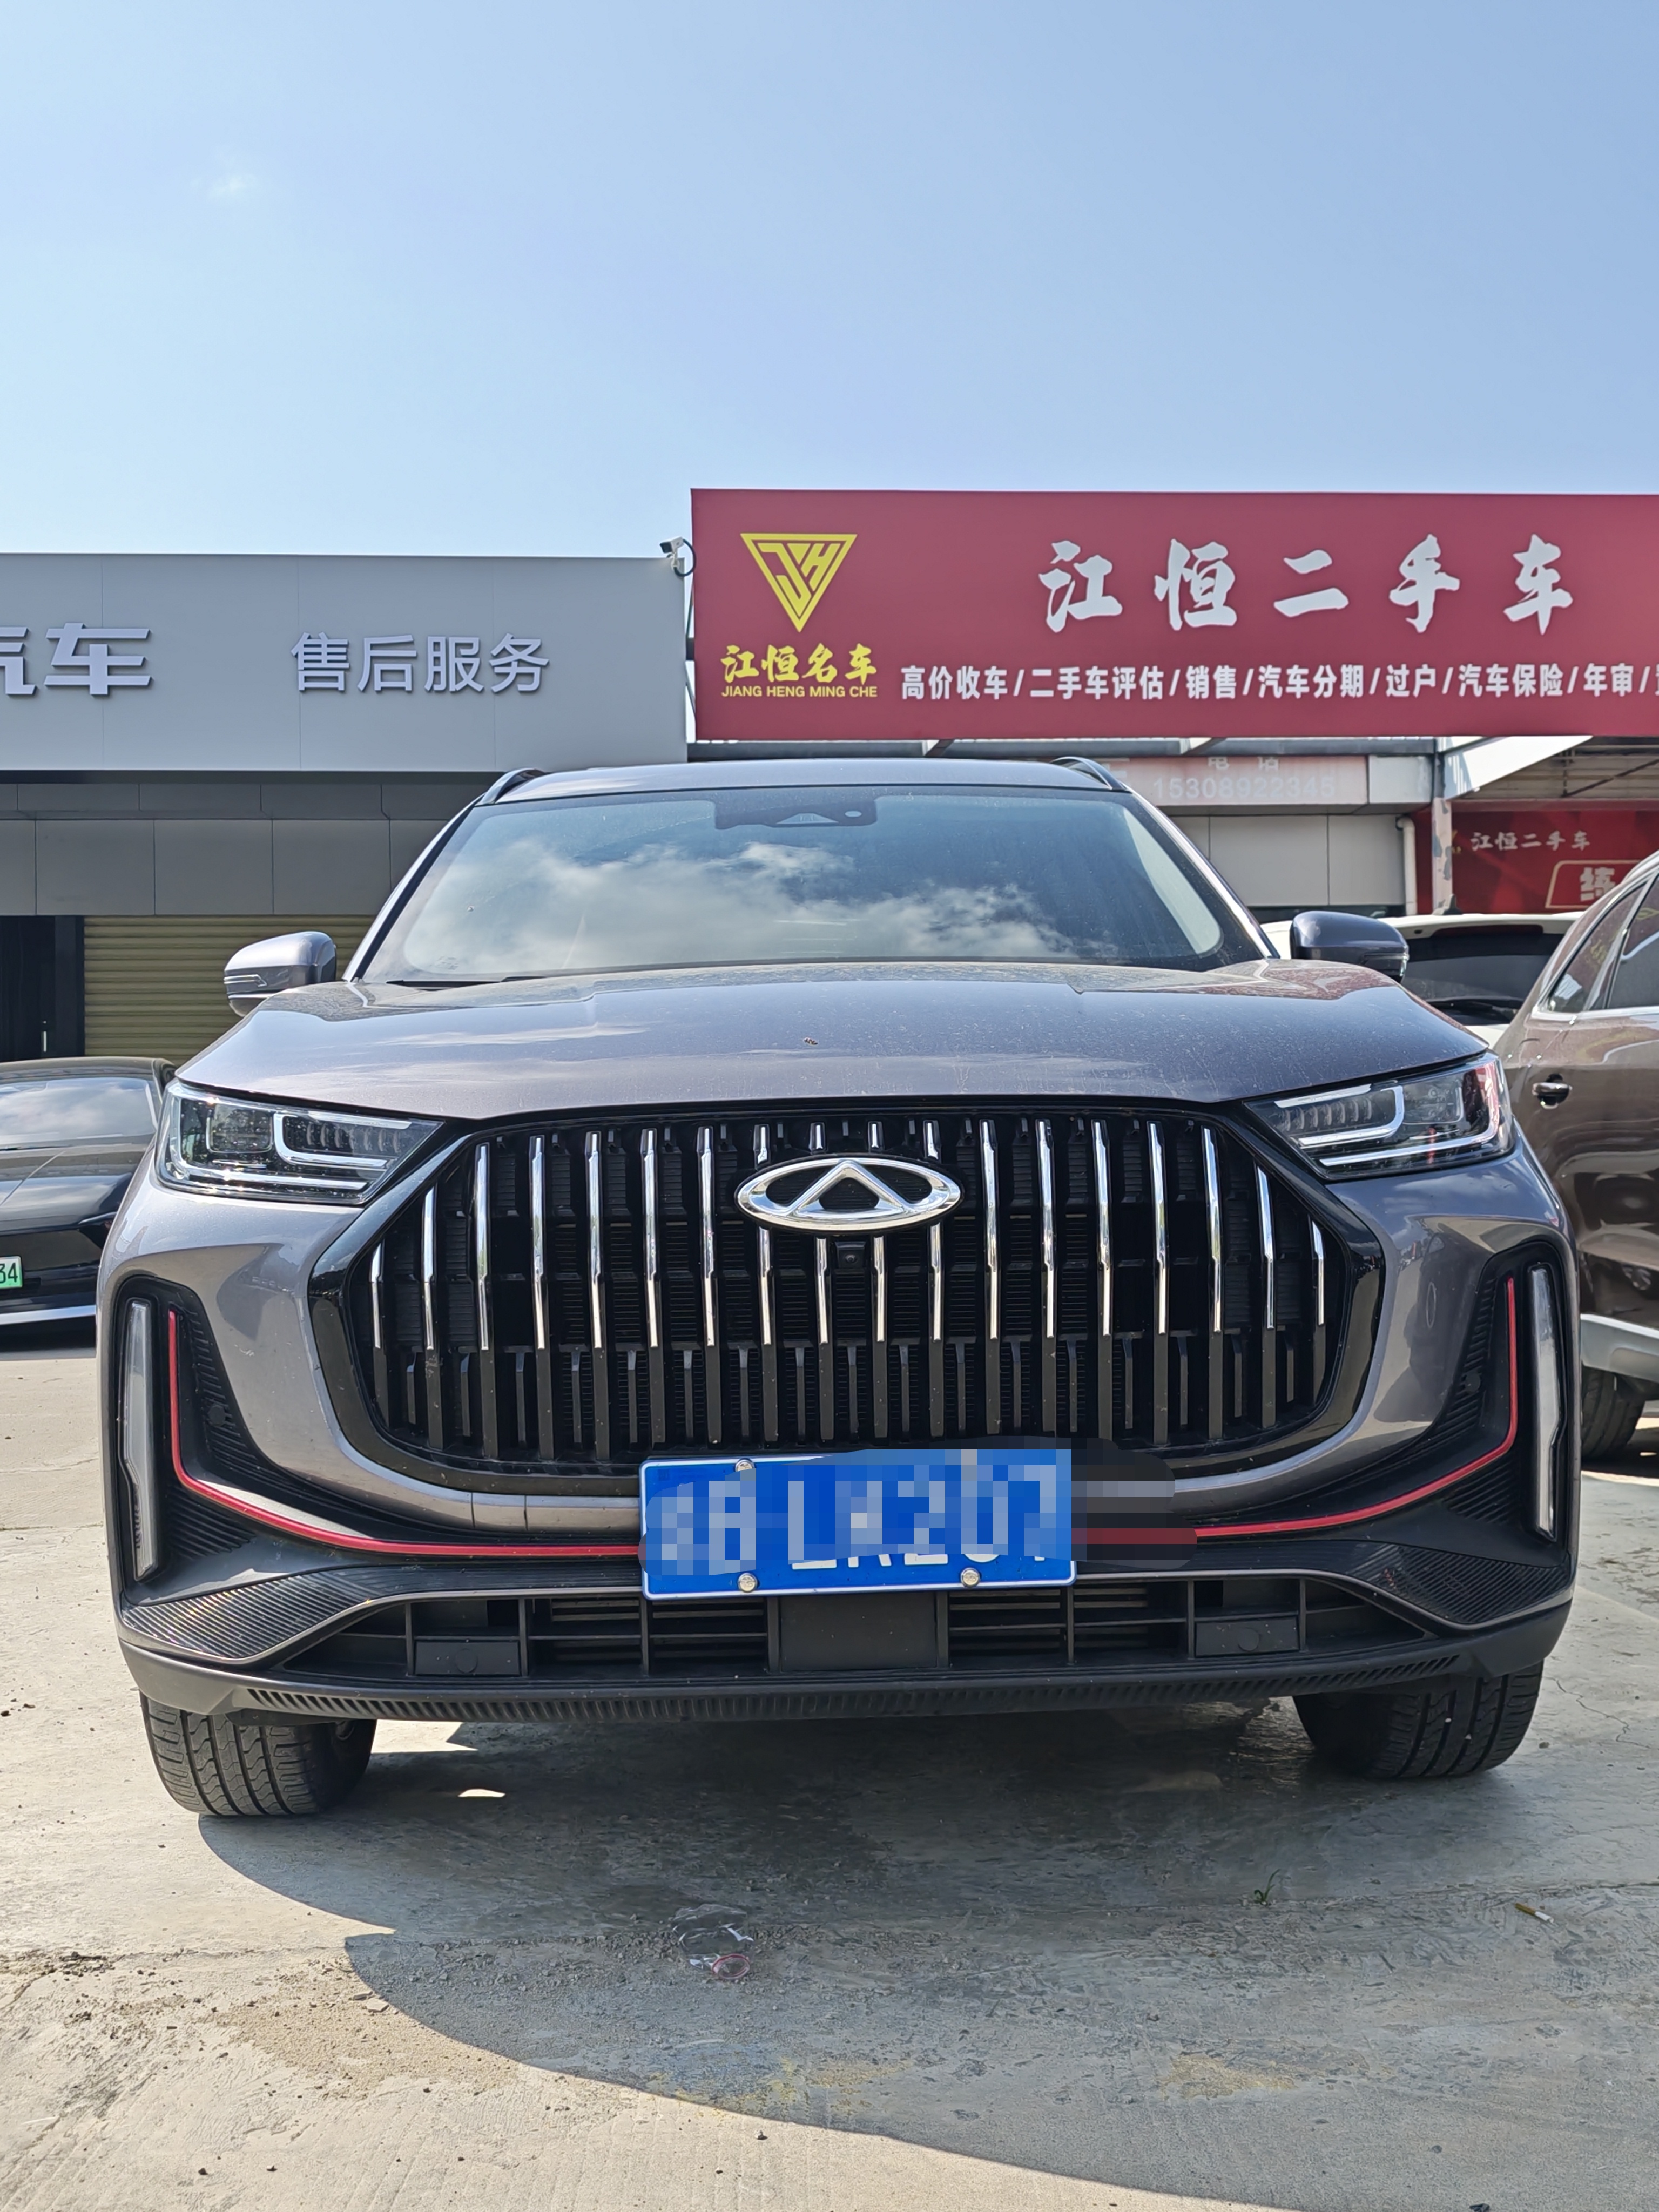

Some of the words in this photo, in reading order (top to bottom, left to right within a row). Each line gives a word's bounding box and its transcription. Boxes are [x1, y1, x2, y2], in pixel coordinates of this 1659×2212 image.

[1038, 534, 1573, 635] 江恒二手车
[291, 632, 550, 693] 售后服务
[720, 642, 876, 685] 江恒名车
[901, 662, 1659, 700] 高价收车/二手车评估/销售/汽车分期/过户/汽车保险/年审/
[721, 686, 762, 697] JIANG
[767, 686, 805, 697] HENG
[810, 686, 845, 697] MING
[849, 686, 878, 697] CHE
[1470, 830, 1590, 851] 江恒二手车
